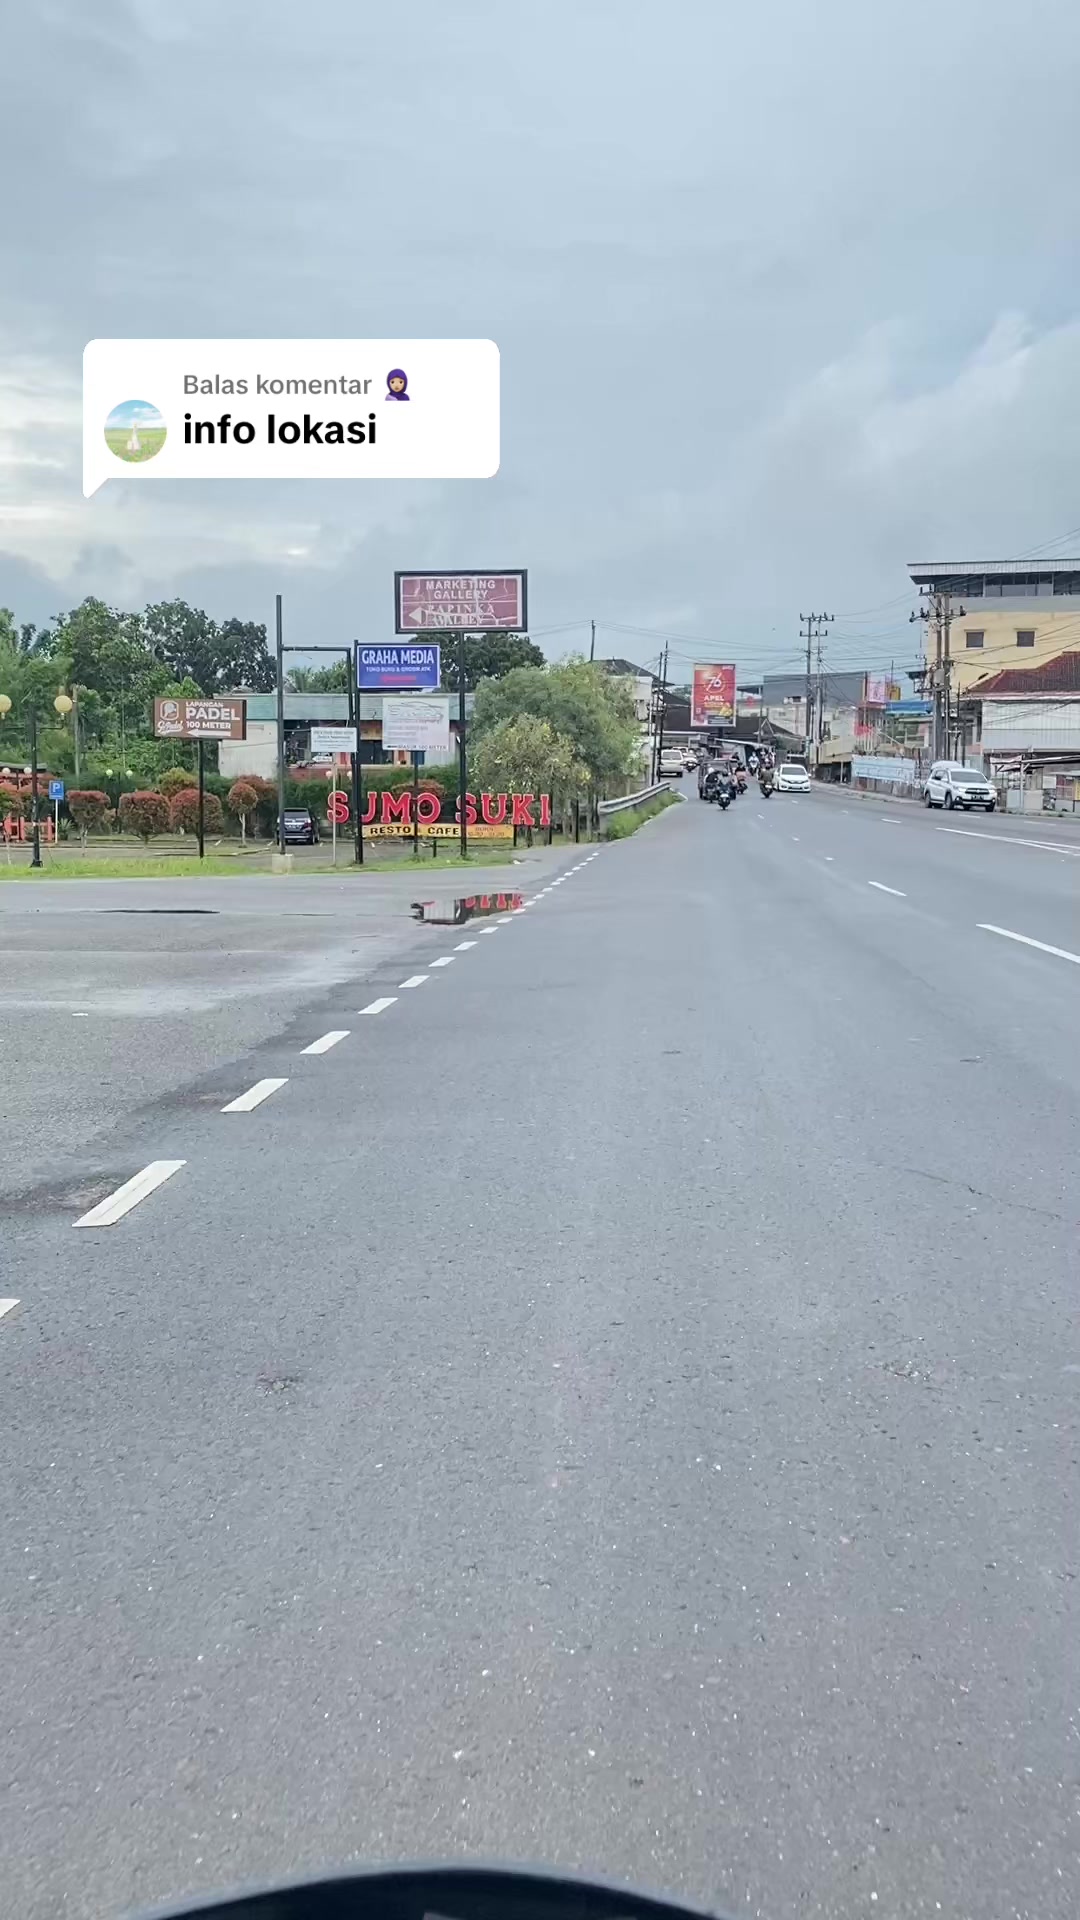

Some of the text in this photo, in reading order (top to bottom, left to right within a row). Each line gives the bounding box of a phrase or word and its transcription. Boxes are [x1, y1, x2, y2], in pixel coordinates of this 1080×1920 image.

[425, 579, 496, 590] MARKETING
[433, 589, 488, 600] GALLERY
[361, 650, 435, 665] GRAHA MEDIA
[185, 707, 241, 721] PADEL
[186, 721, 232, 730] 100 METER
[52, 783, 61, 793] P
[327, 791, 550, 826] SUMO SUKI
[370, 825, 412, 835] RESTO
[427, 826, 460, 835] CAFE
